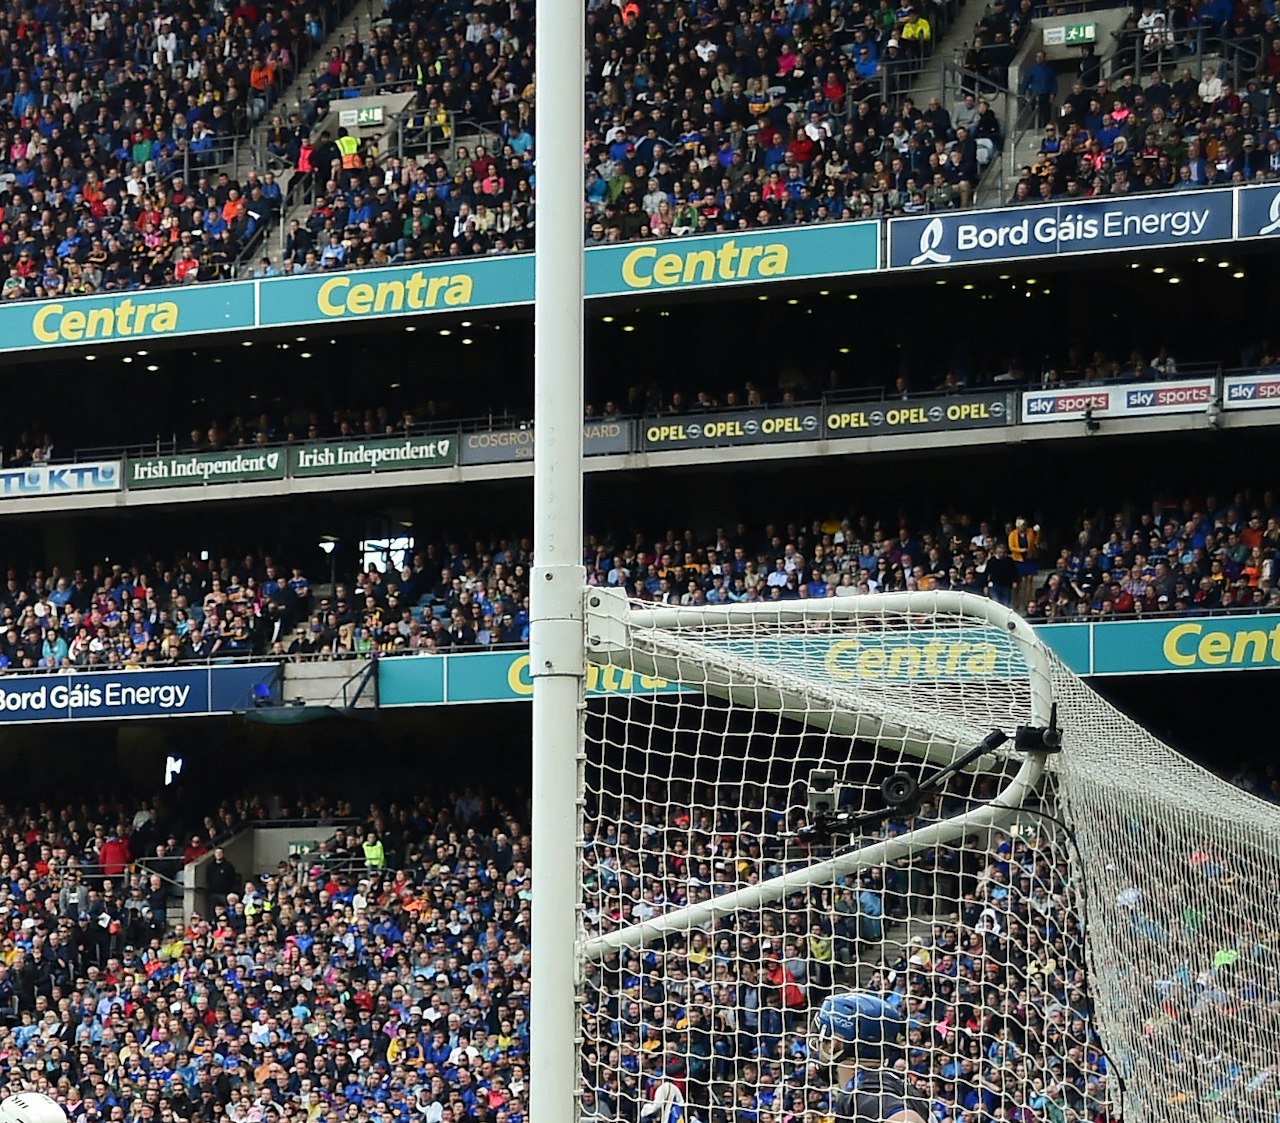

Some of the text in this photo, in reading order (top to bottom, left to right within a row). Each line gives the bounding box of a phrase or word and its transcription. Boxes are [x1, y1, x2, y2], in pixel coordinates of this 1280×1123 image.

[957, 209, 1209, 251] Bord Gáis Energy
[622, 240, 789, 288] Centra
[317, 271, 474, 317] Centra
[32, 299, 178, 342] Centra
[1129, 388, 1208, 408] sky sports
[1230, 383, 1280, 399] sky spo
[886, 408, 928, 425] OPEL
[947, 404, 989, 421] OPEL
[1030, 399, 1053, 415] sky
[703, 421, 743, 438] OPEL
[762, 417, 802, 433] OPEL
[827, 412, 868, 429] OPEL
[647, 425, 687, 442] OPEL
[299, 441, 435, 467] Irish Independent
[134, 454, 265, 480] Irish Independent
[1163, 623, 1280, 666] Cent
[825, 638, 997, 681] Centra
[49, 684, 102, 709] Gáis
[105, 682, 190, 709] Energy
